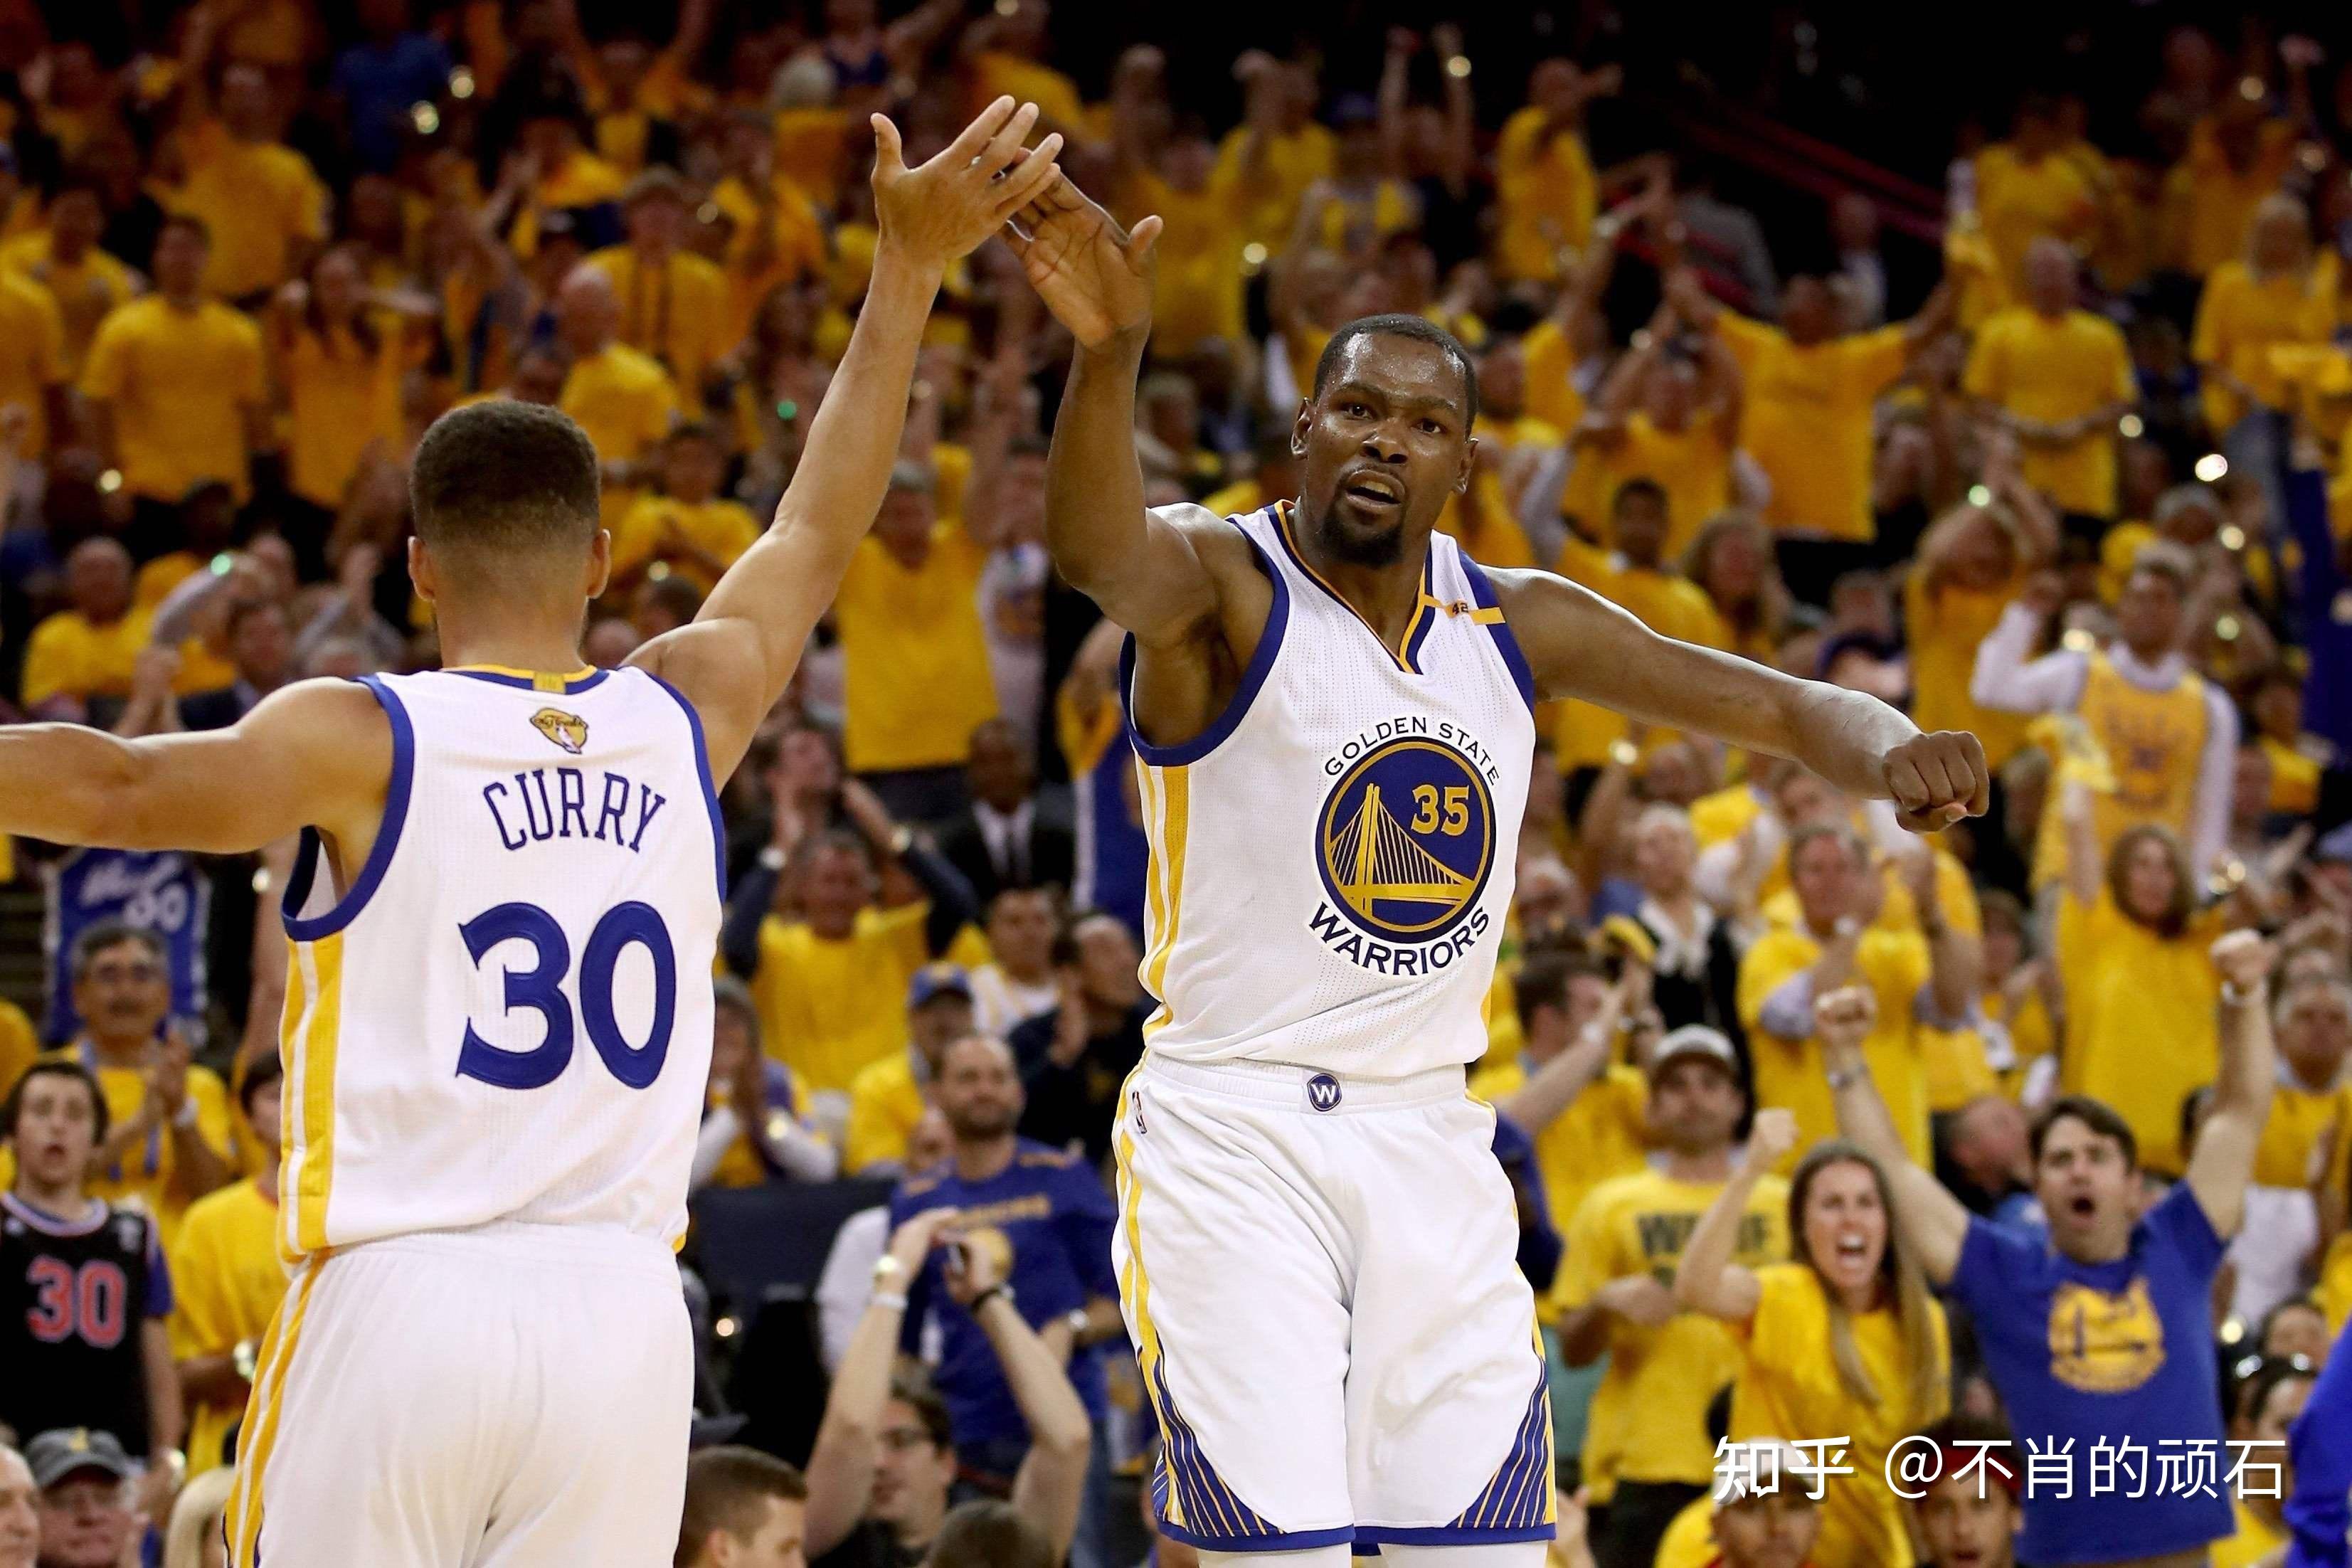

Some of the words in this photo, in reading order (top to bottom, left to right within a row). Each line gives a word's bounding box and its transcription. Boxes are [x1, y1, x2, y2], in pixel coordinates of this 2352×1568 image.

[1325, 716, 1427, 777] GOLDEN
[1439, 722, 1500, 786] STATE
[484, 768, 667, 854] CURRY
[1411, 783, 1470, 837] 35
[1308, 901, 1489, 976] WARRIORS
[455, 901, 677, 1091] 30
[1310, 1084, 1337, 1103] W
[25, 1254, 127, 1350] 30
